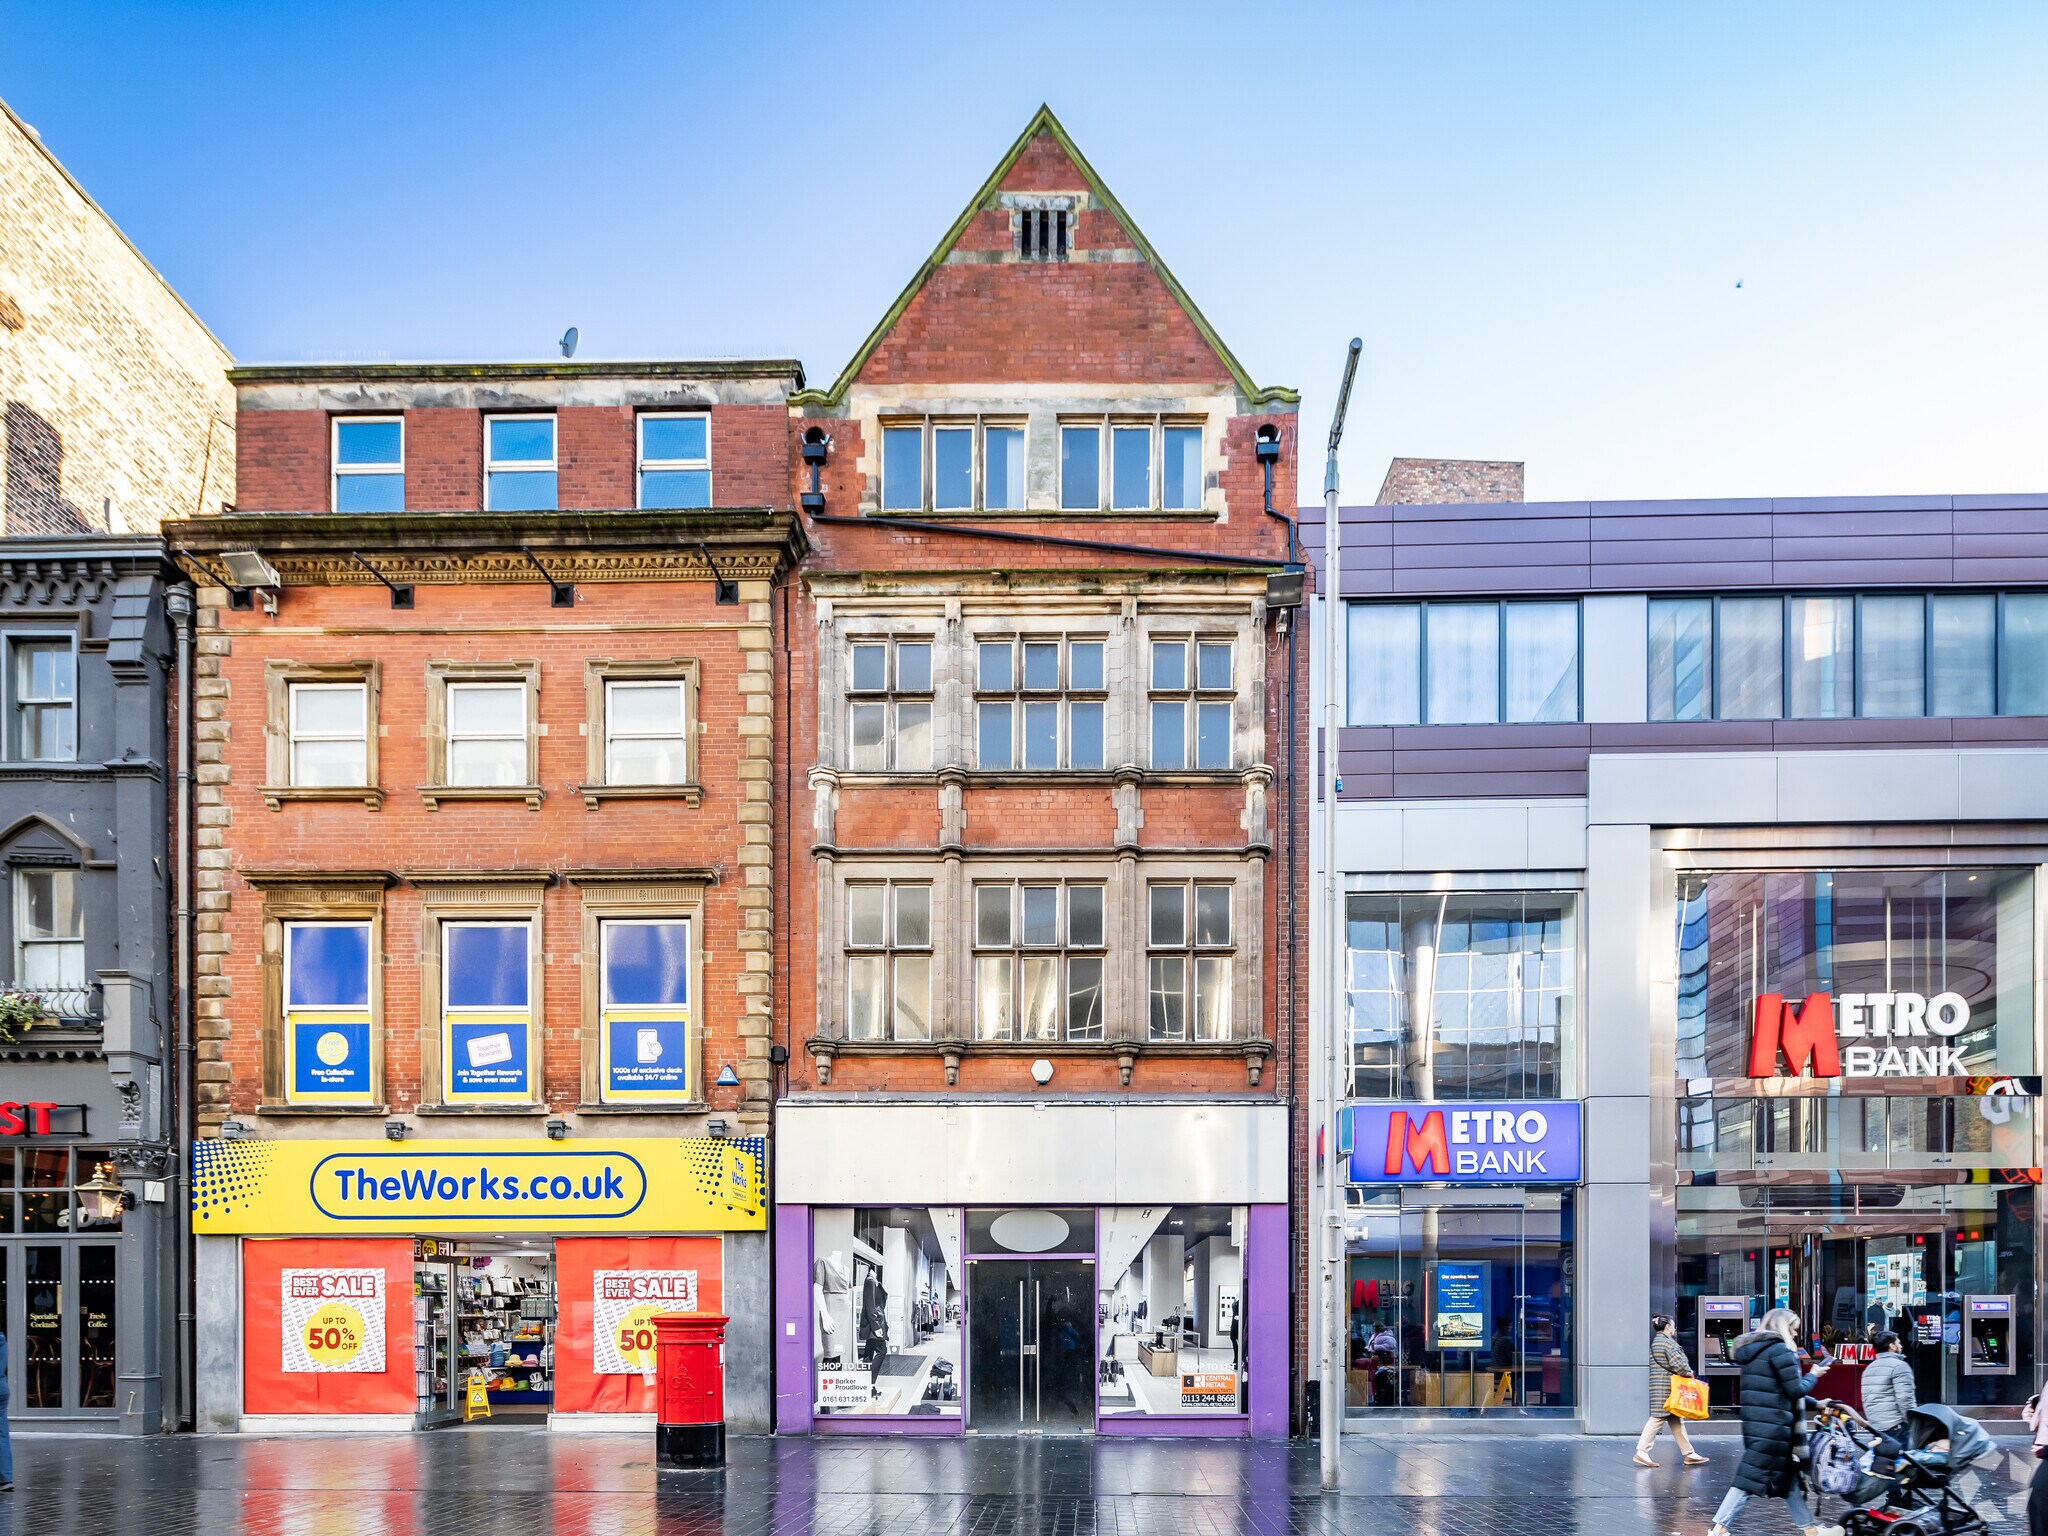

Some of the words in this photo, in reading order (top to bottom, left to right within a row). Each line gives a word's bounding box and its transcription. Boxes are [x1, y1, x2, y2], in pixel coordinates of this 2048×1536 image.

[1748, 992, 1970, 1077] METRO
[1846, 1046, 1969, 1076] BANK
[470, 1069, 496, 1077] Together
[1385, 1110, 1548, 1174] METRO
[735, 1157, 744, 1172] The
[1456, 1150, 1547, 1174] BANK
[334, 1166, 624, 1201] TheWorks.co.uk
[293, 1277, 318, 1287] BEST
[293, 1287, 318, 1296] EVER
[321, 1277, 374, 1296] SALE
[605, 1279, 630, 1288] BEST
[633, 1279, 687, 1298] SALE
[605, 1288, 630, 1297] EVER
[308, 1327, 355, 1350] 50%
